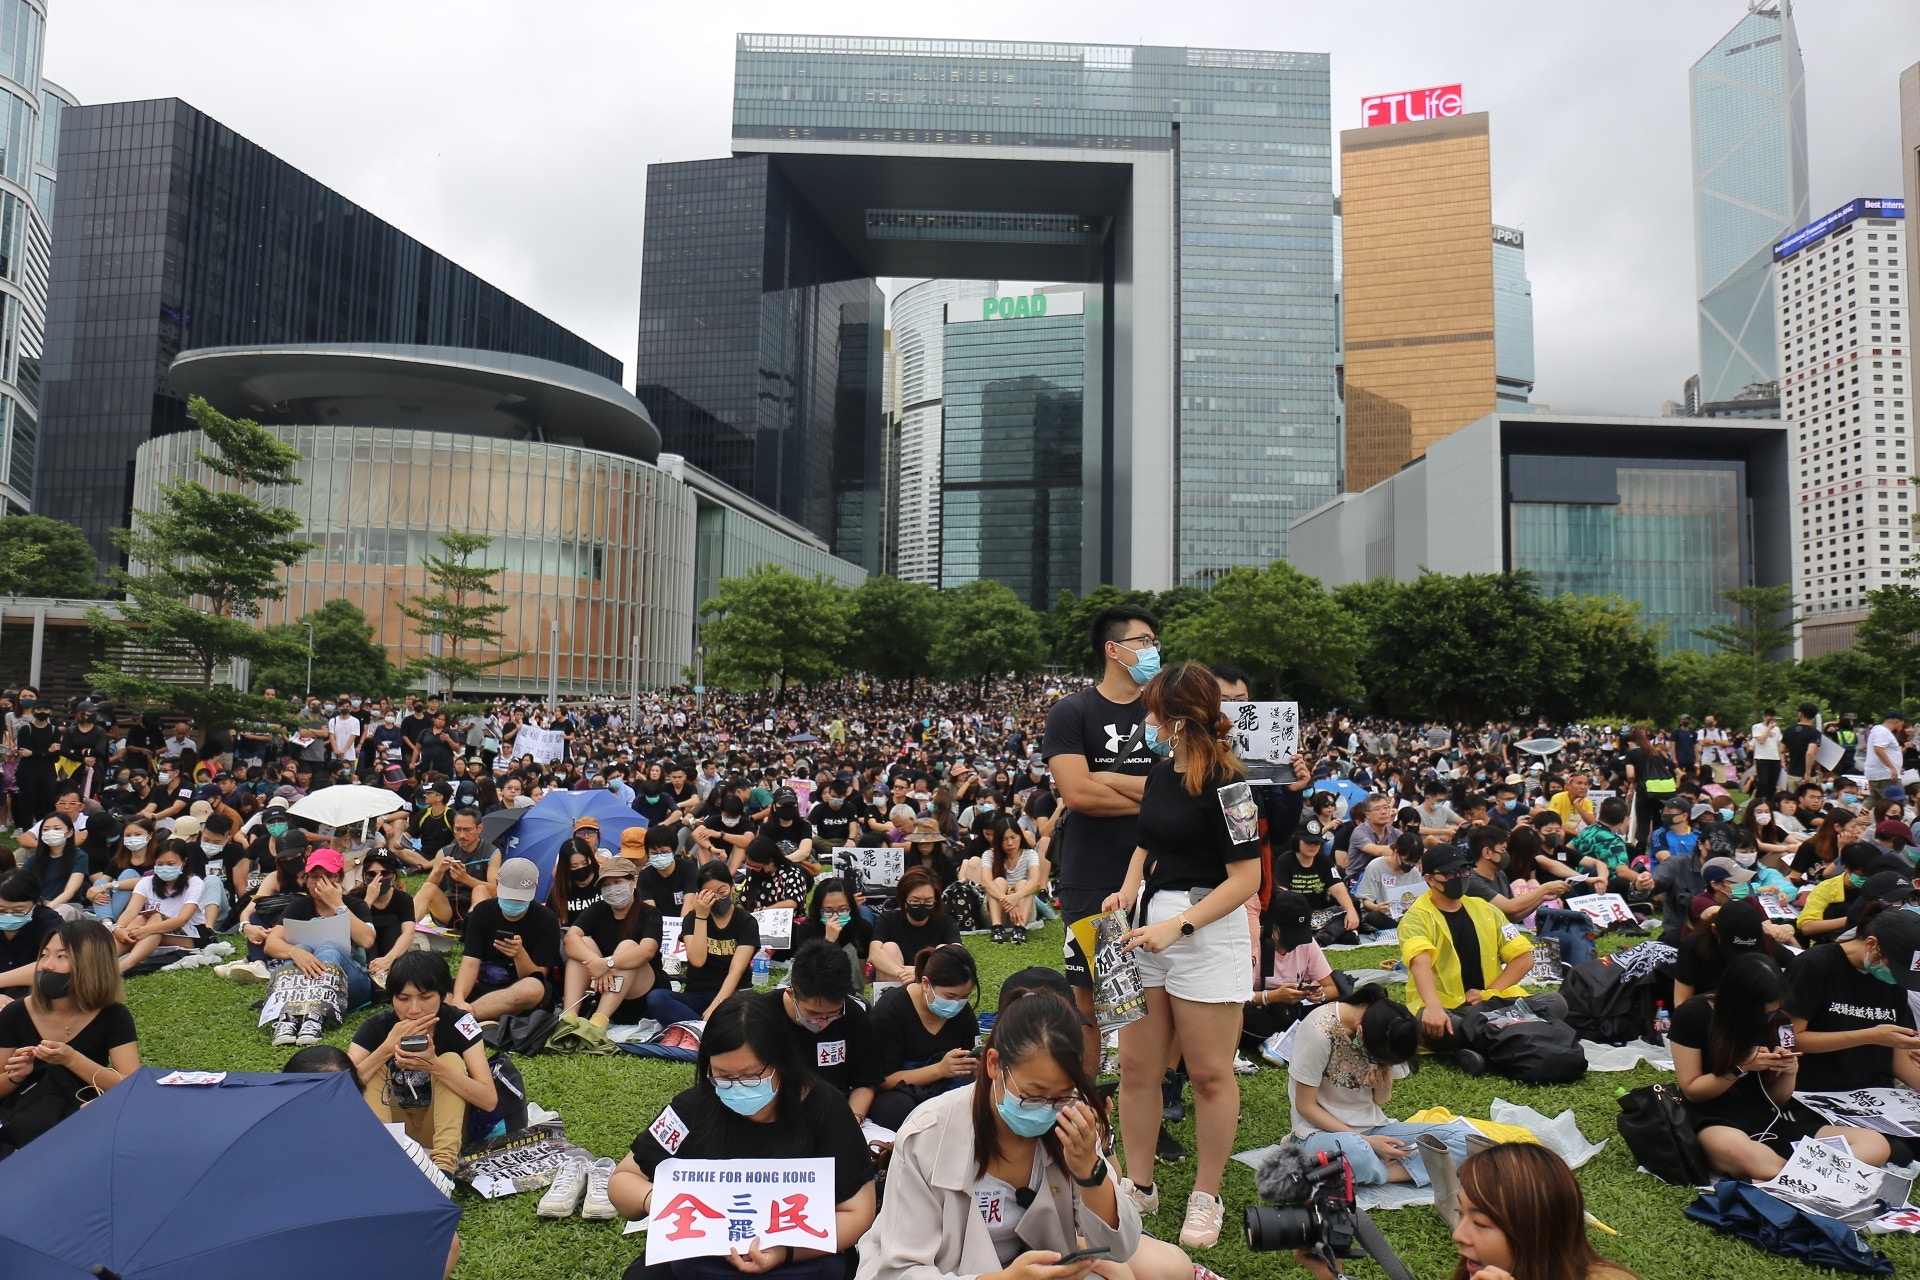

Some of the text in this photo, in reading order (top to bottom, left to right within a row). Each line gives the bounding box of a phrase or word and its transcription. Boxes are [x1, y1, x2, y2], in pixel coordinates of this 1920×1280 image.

[1362, 90, 1461, 128] FTLife
[1493, 228, 1521, 245] IPPO
[983, 294, 1047, 321] POAD
[1282, 707, 1296, 758] 香港人
[568, 894, 603, 911] HÈAVÉ
[820, 1048, 831, 1064] 全
[672, 1170, 816, 1183] STRKIE FOR HONG KONG
[652, 1193, 727, 1242] 全
[765, 1193, 829, 1239] 民
[988, 1198, 1002, 1223] 民
